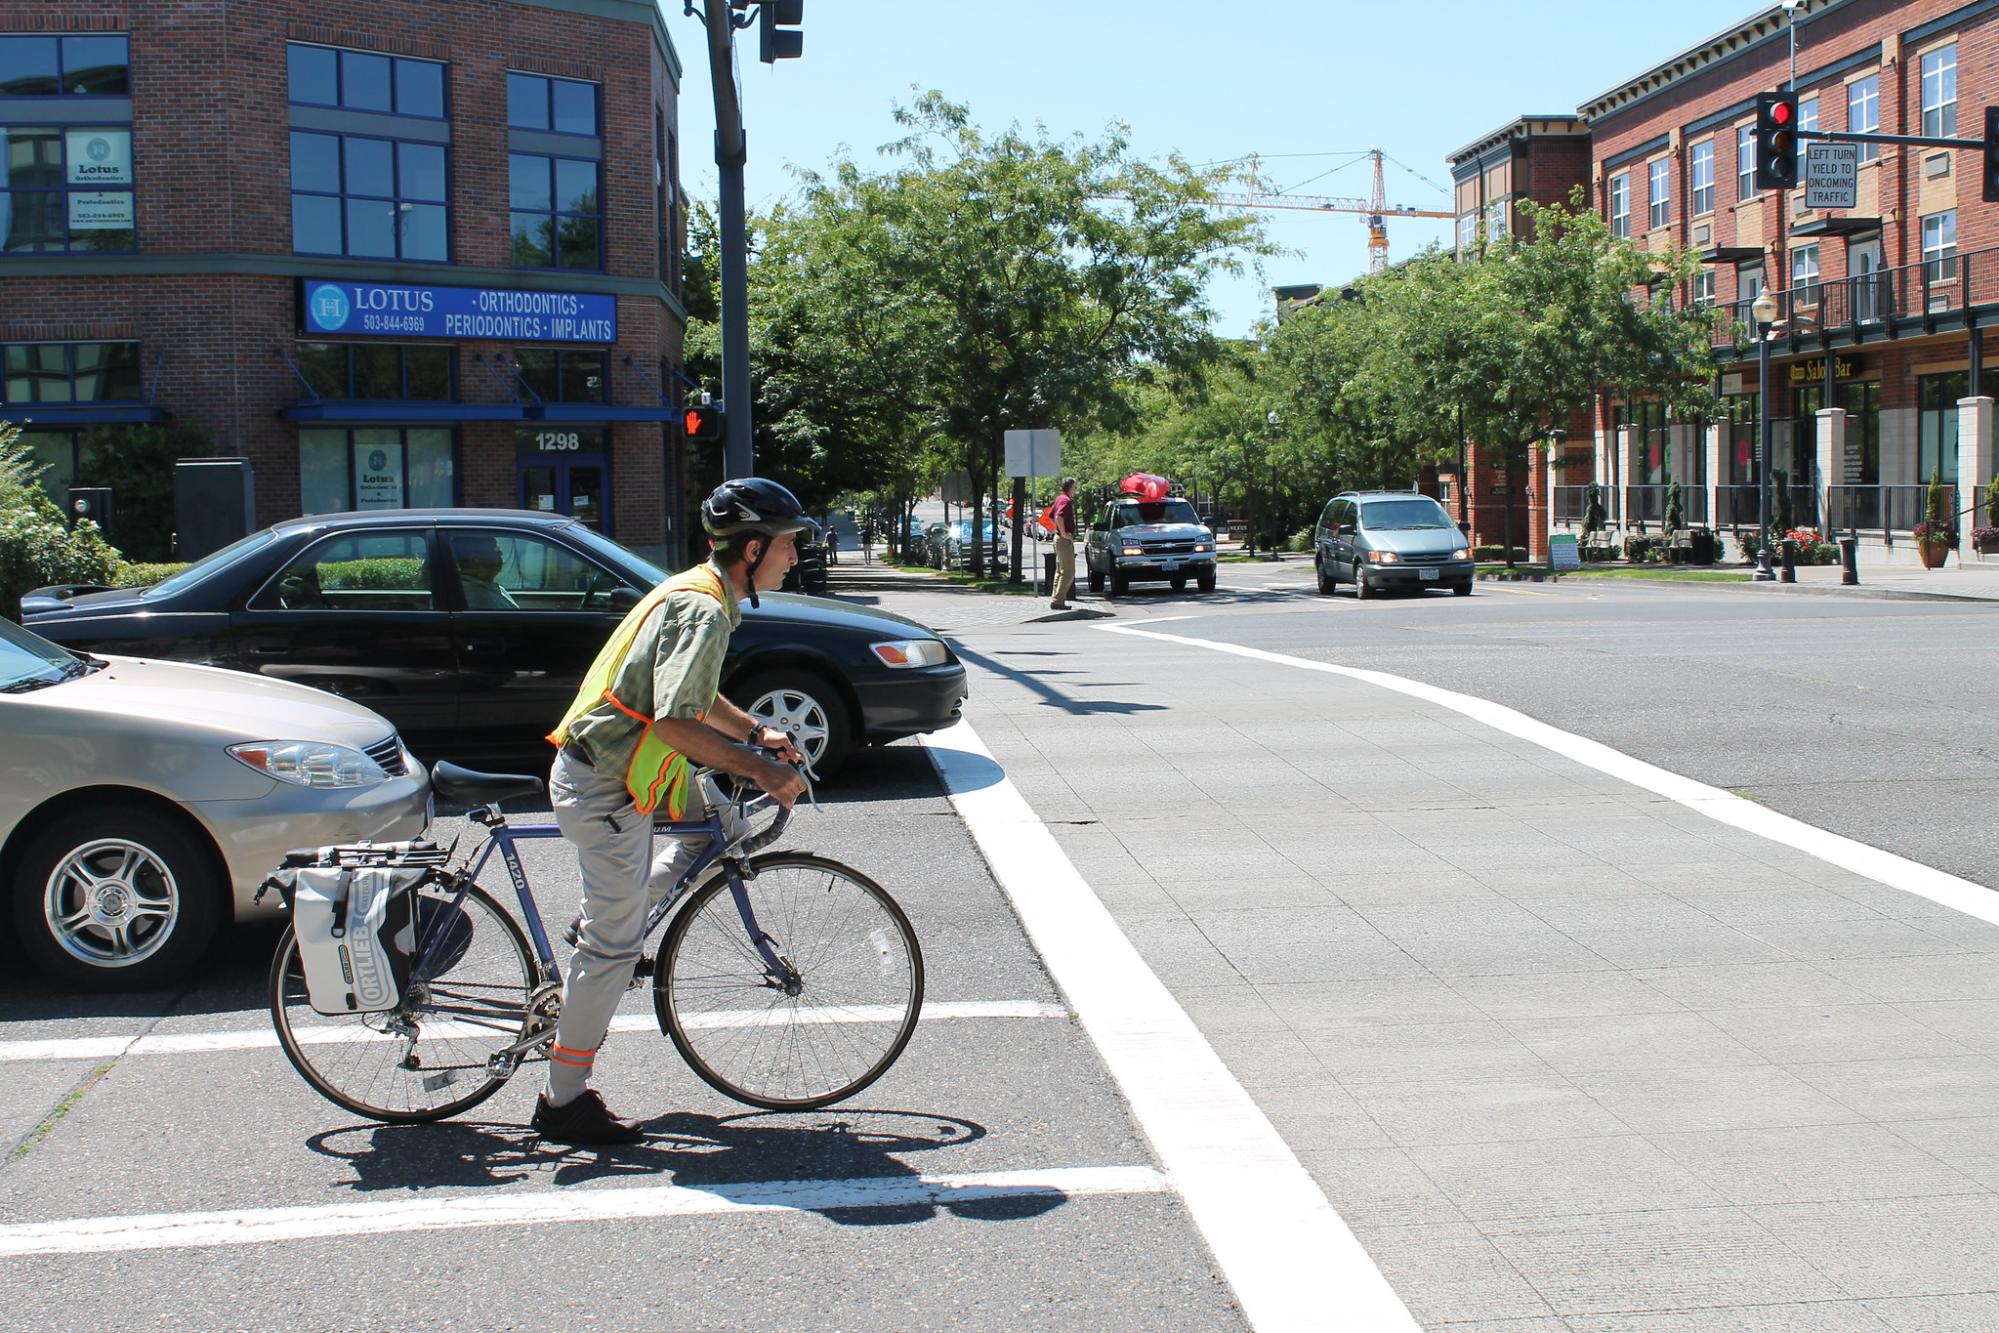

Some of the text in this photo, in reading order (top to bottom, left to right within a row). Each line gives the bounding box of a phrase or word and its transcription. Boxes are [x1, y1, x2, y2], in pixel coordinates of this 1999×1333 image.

[1809, 149, 1855, 159] LEFT TURN
[79, 165, 120, 174] Lotus
[1812, 163, 1851, 174] YIELD TO
[1808, 178, 1854, 188] ONCOMING
[1813, 191, 1849, 202] TRAFFIC
[354, 287, 434, 312] LOTUS
[479, 291, 577, 315] ORTHODONTICS
[364, 314, 425, 331] 503-844-6969
[446, 314, 611, 340] PERIODONTICS IMPLANTS
[1807, 360, 1825, 381] Salo
[1834, 357, 1851, 378] Bar
[535, 432, 580, 451] 1298
[363, 474, 394, 483] Lotus
[507, 852, 525, 890] 1420
[647, 879, 685, 926] REK
[352, 925, 382, 1000] ORTLIEB
